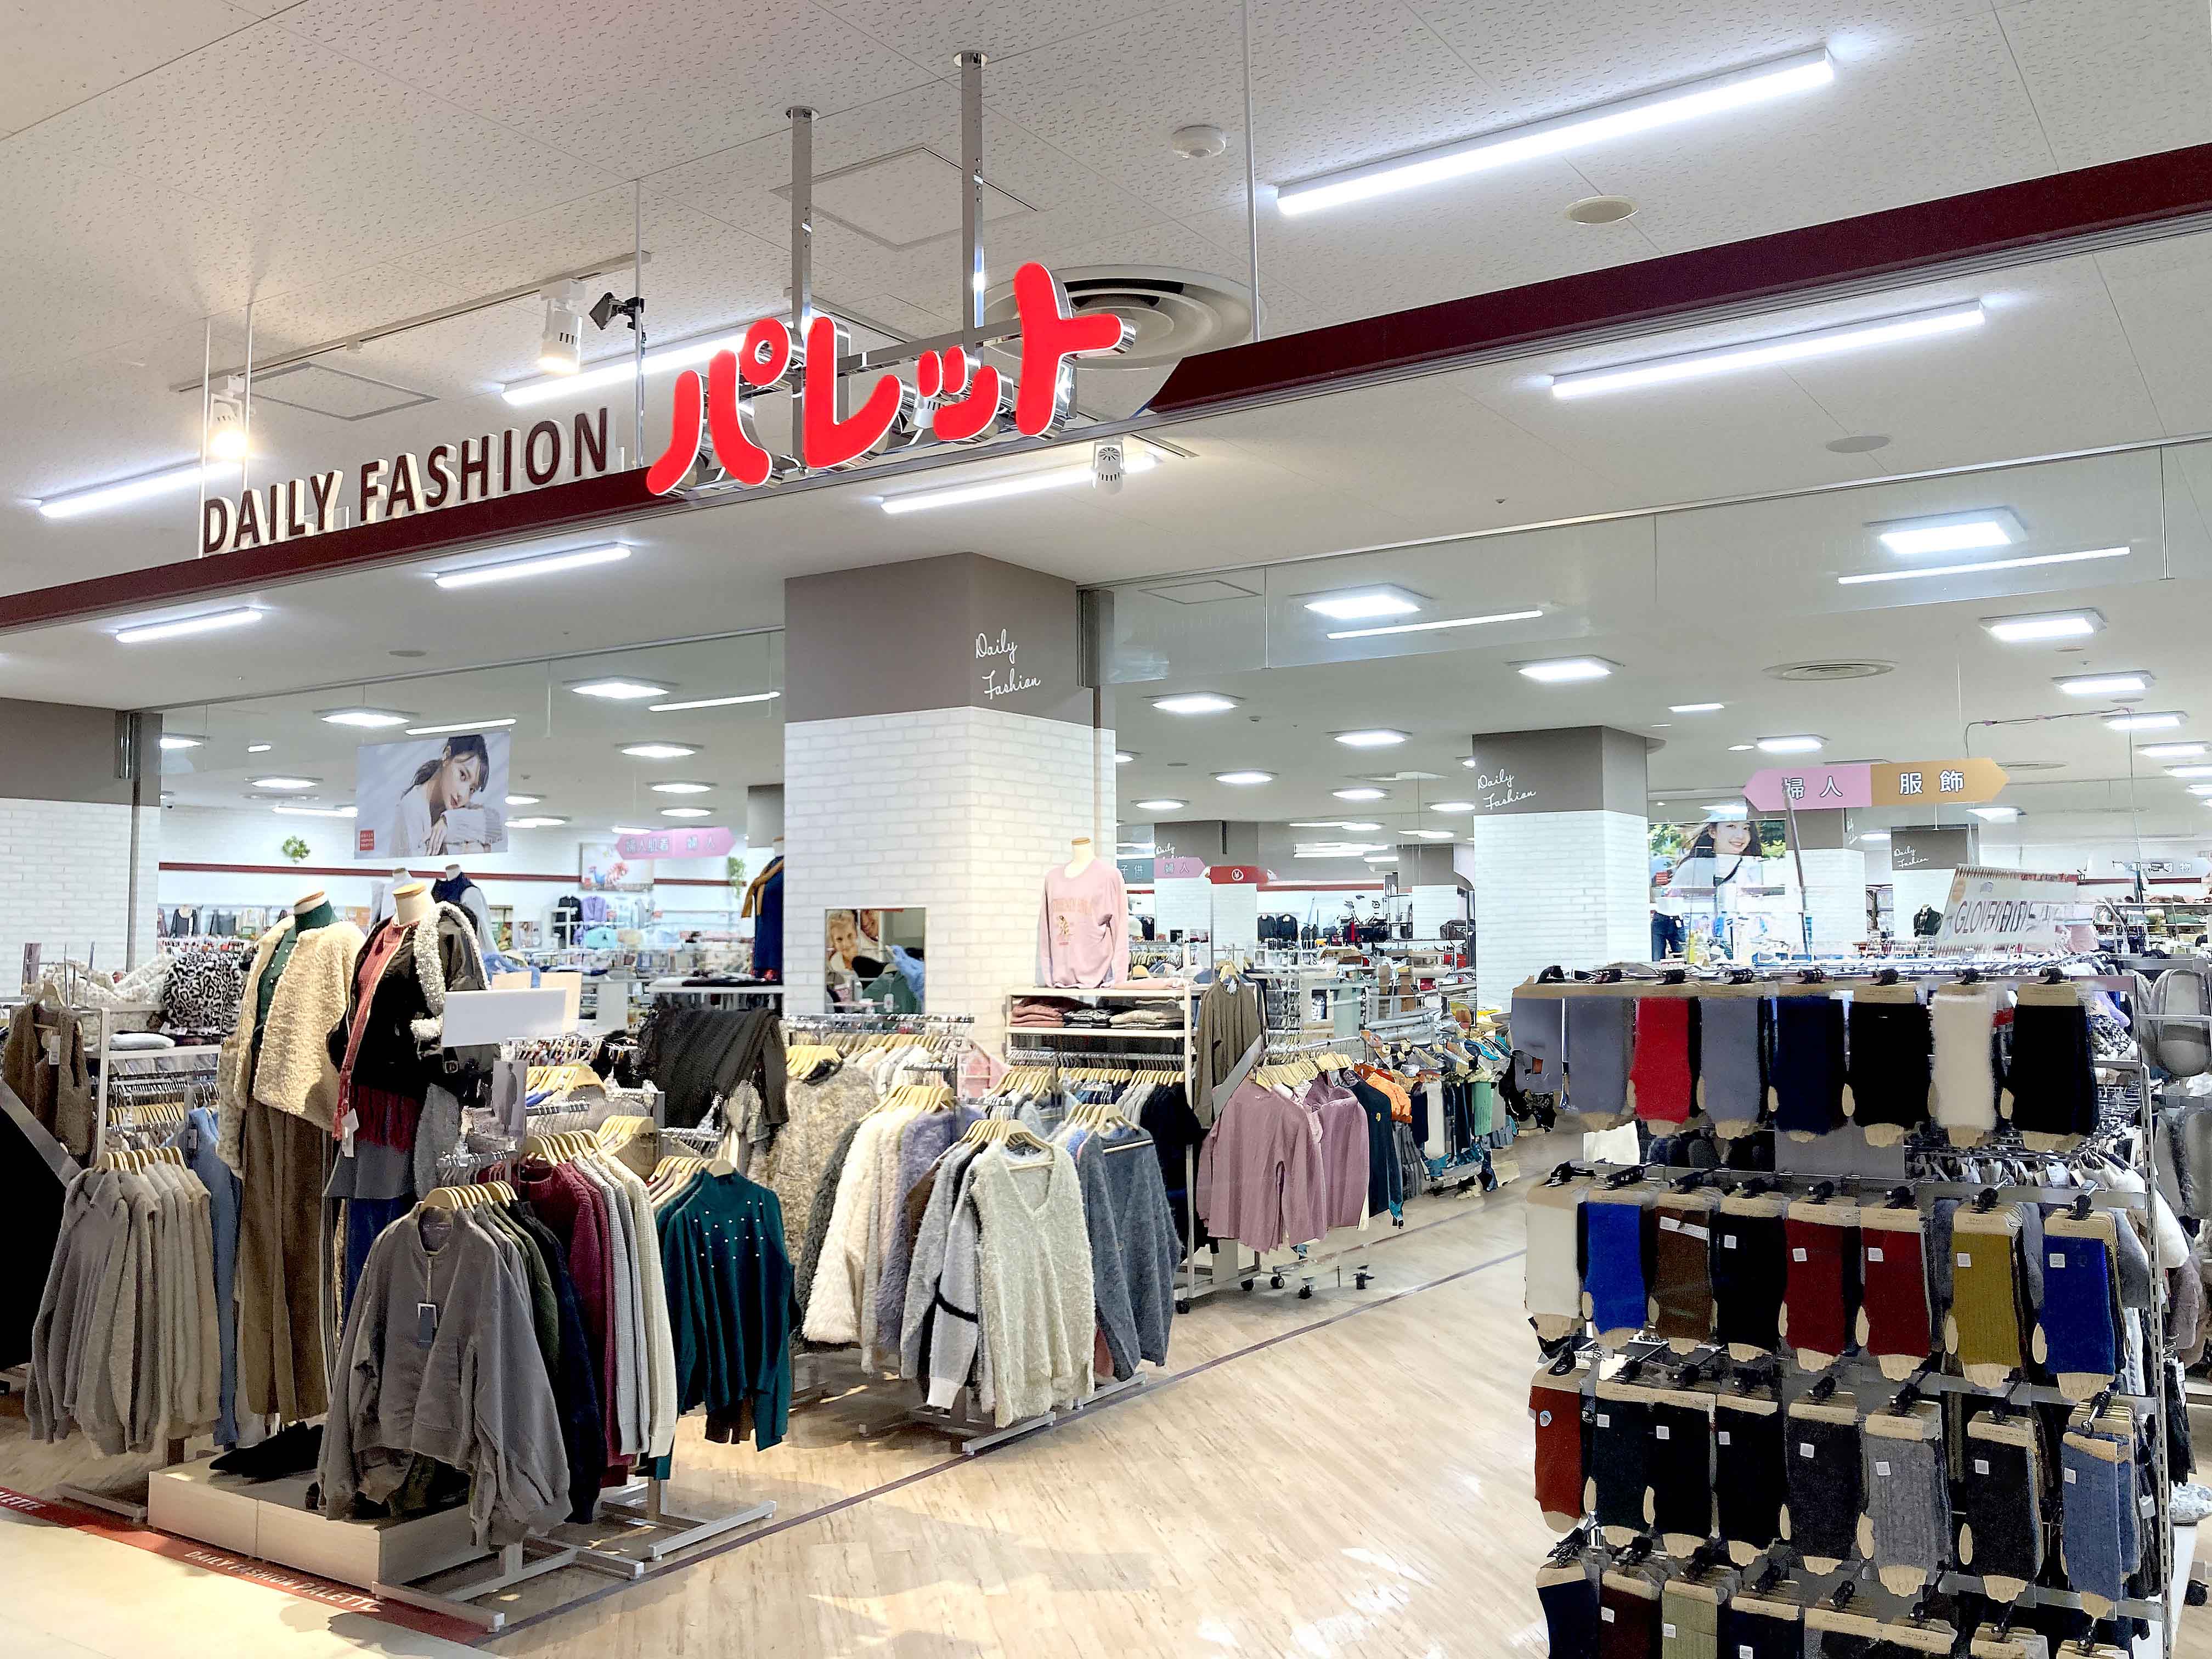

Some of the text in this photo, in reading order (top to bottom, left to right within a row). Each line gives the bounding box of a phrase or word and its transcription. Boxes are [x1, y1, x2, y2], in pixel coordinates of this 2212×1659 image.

[646, 262, 1125, 496] パレット
[204, 408, 608, 552] DAILY FASHION
[975, 629, 1018, 664] Daily
[982, 668, 1041, 699] Fashion
[1477, 768, 1514, 790] Daily
[1782, 770, 1965, 800] 婦人 服飾
[1483, 789, 1536, 810] Fashion
[1156, 843, 1175, 855] Daily
[1894, 845, 1916, 857] Daily
[1898, 857, 1929, 868] Fashion
[184, 1550, 385, 1612] DAILY FASHION PALETTE
